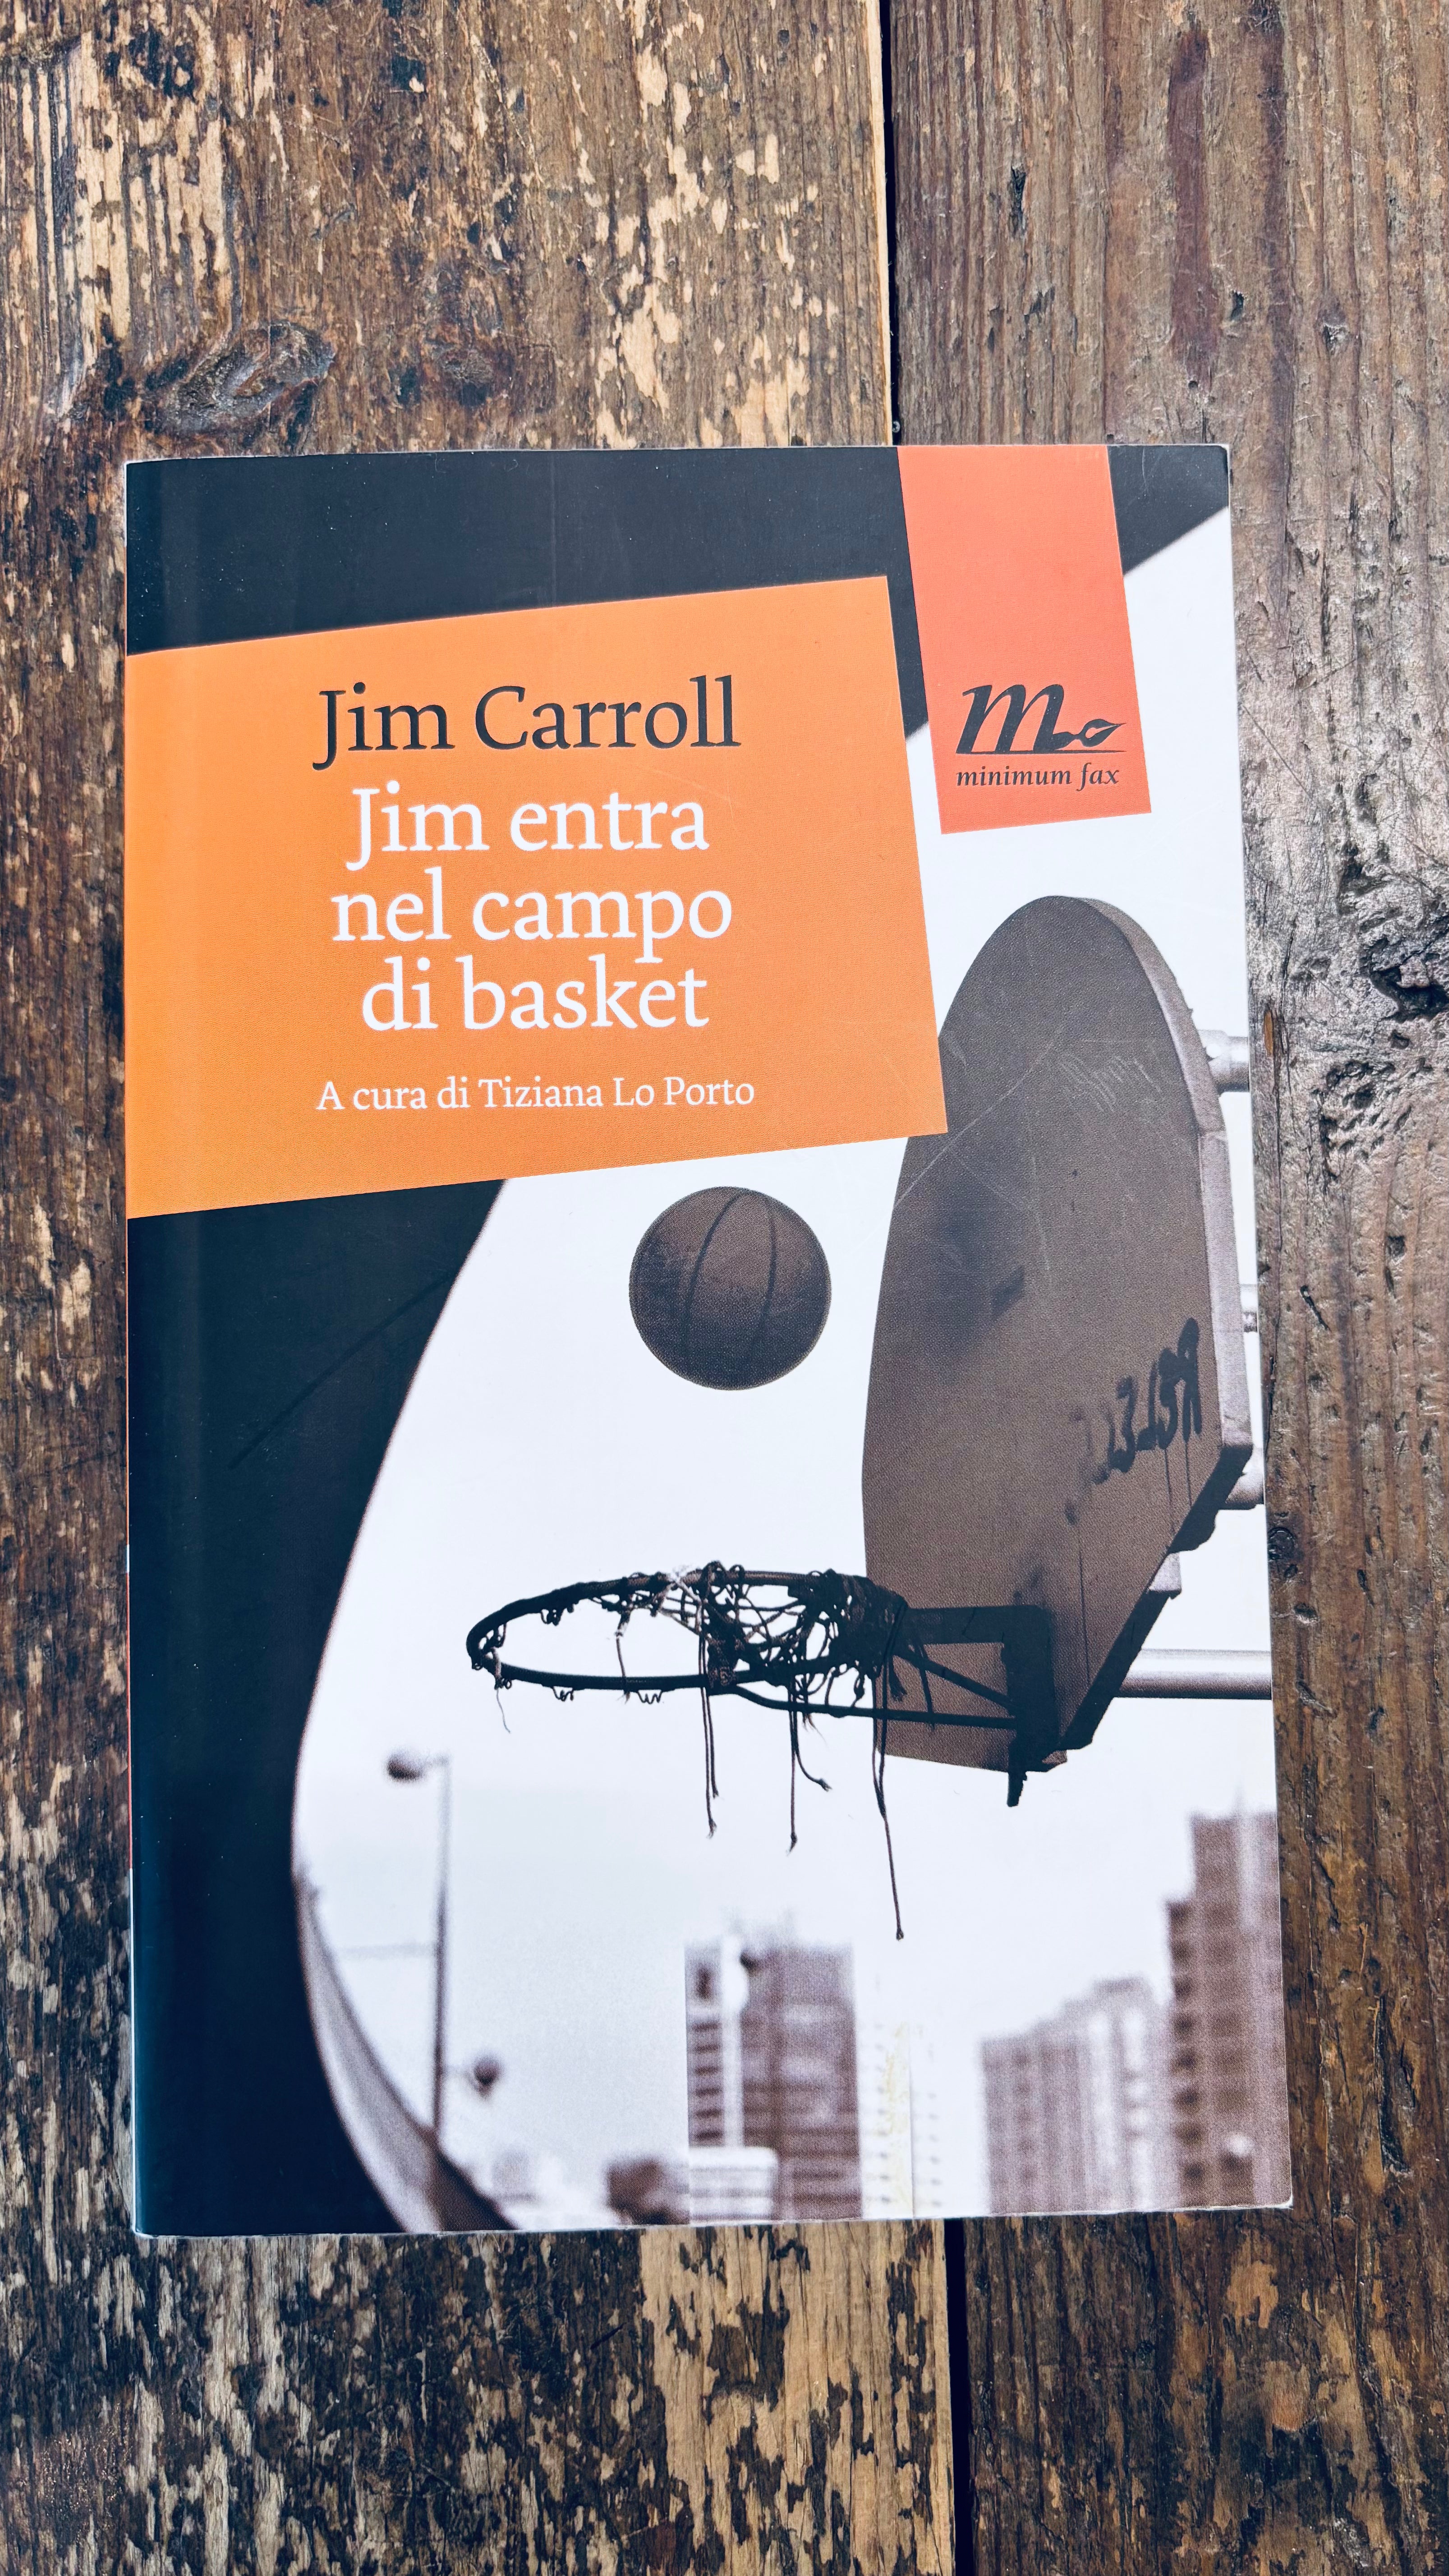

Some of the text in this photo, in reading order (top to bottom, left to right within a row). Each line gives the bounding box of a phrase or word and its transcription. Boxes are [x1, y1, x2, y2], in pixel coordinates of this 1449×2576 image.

[312, 675, 741, 771] Jim Carroll
[957, 762, 1119, 791] minimum fax
[346, 780, 710, 871] Jim entra
[331, 866, 732, 963] nel campo
[362, 954, 709, 1031] di basket
[316, 1076, 754, 1110] A cura di Tiziana Lo Porto
